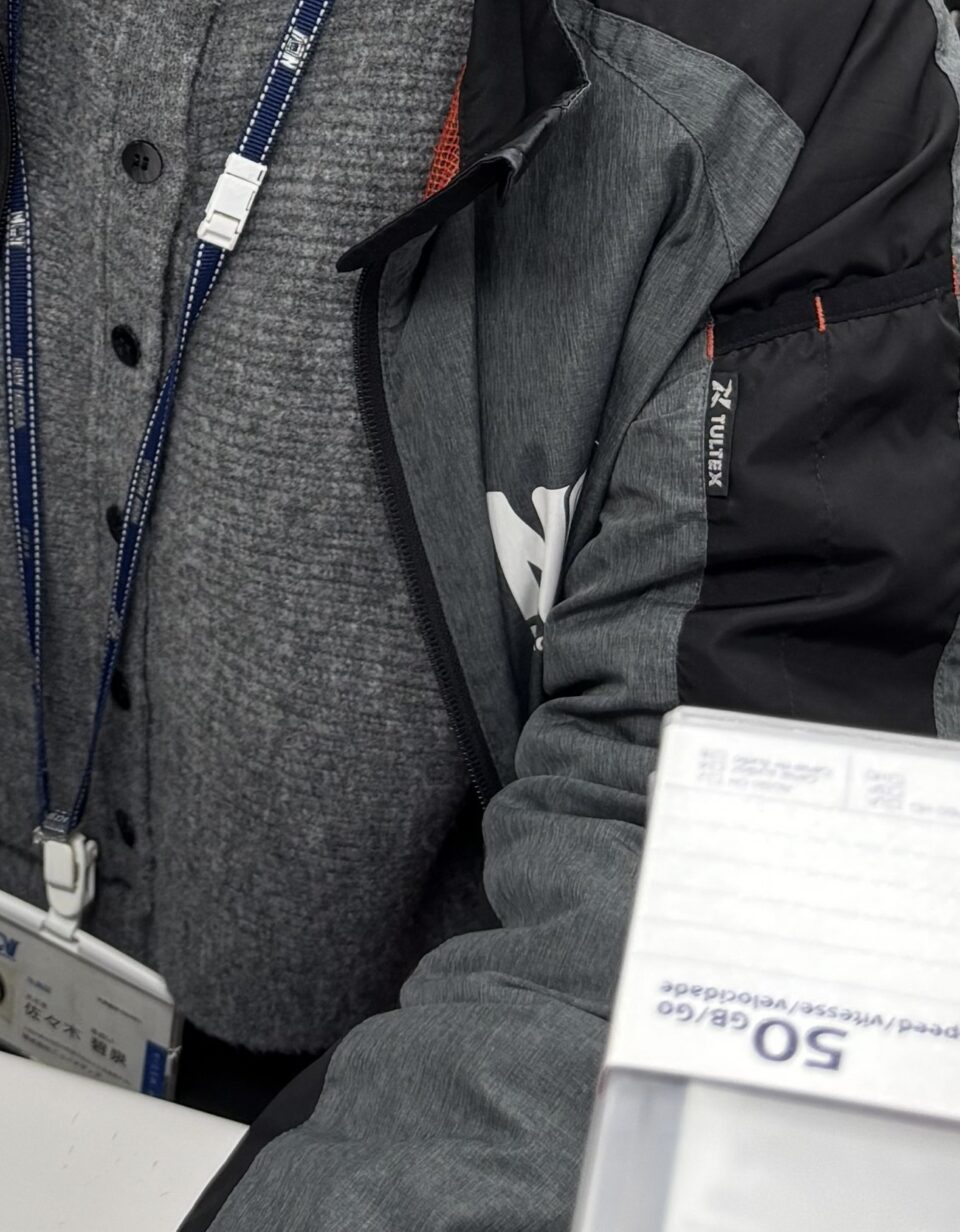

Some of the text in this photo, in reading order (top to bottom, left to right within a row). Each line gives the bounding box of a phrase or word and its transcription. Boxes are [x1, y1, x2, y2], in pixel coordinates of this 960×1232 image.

[708, 414, 726, 488] TULTEX
[656, 999, 849, 1071] 50 GB/Go
[660, 981, 960, 1039] peed/vitesse/velocidade
